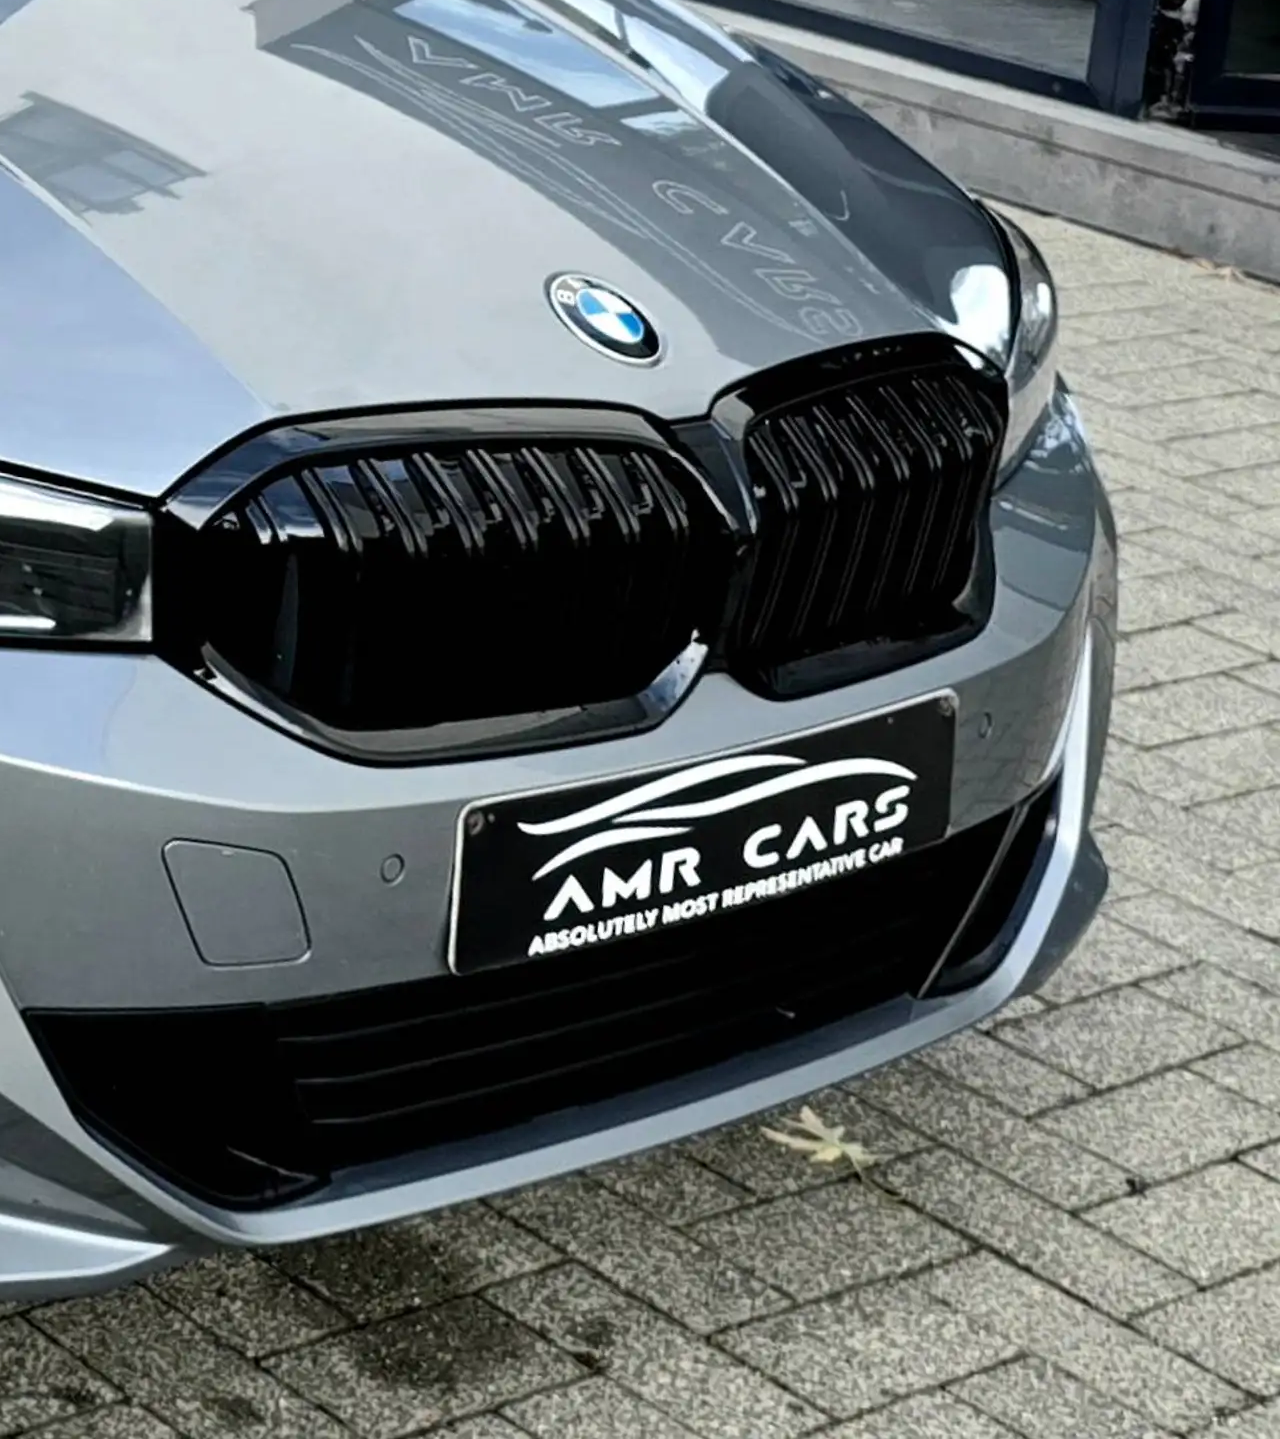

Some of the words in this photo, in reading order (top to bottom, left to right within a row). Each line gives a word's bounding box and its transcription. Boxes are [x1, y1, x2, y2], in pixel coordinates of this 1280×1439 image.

[527, 907, 659, 957] ABSOLUTELY
[661, 891, 720, 925] MOST
[868, 836, 905, 864] CAR
[543, 846, 702, 922] AMR
[742, 784, 911, 869] CARS
